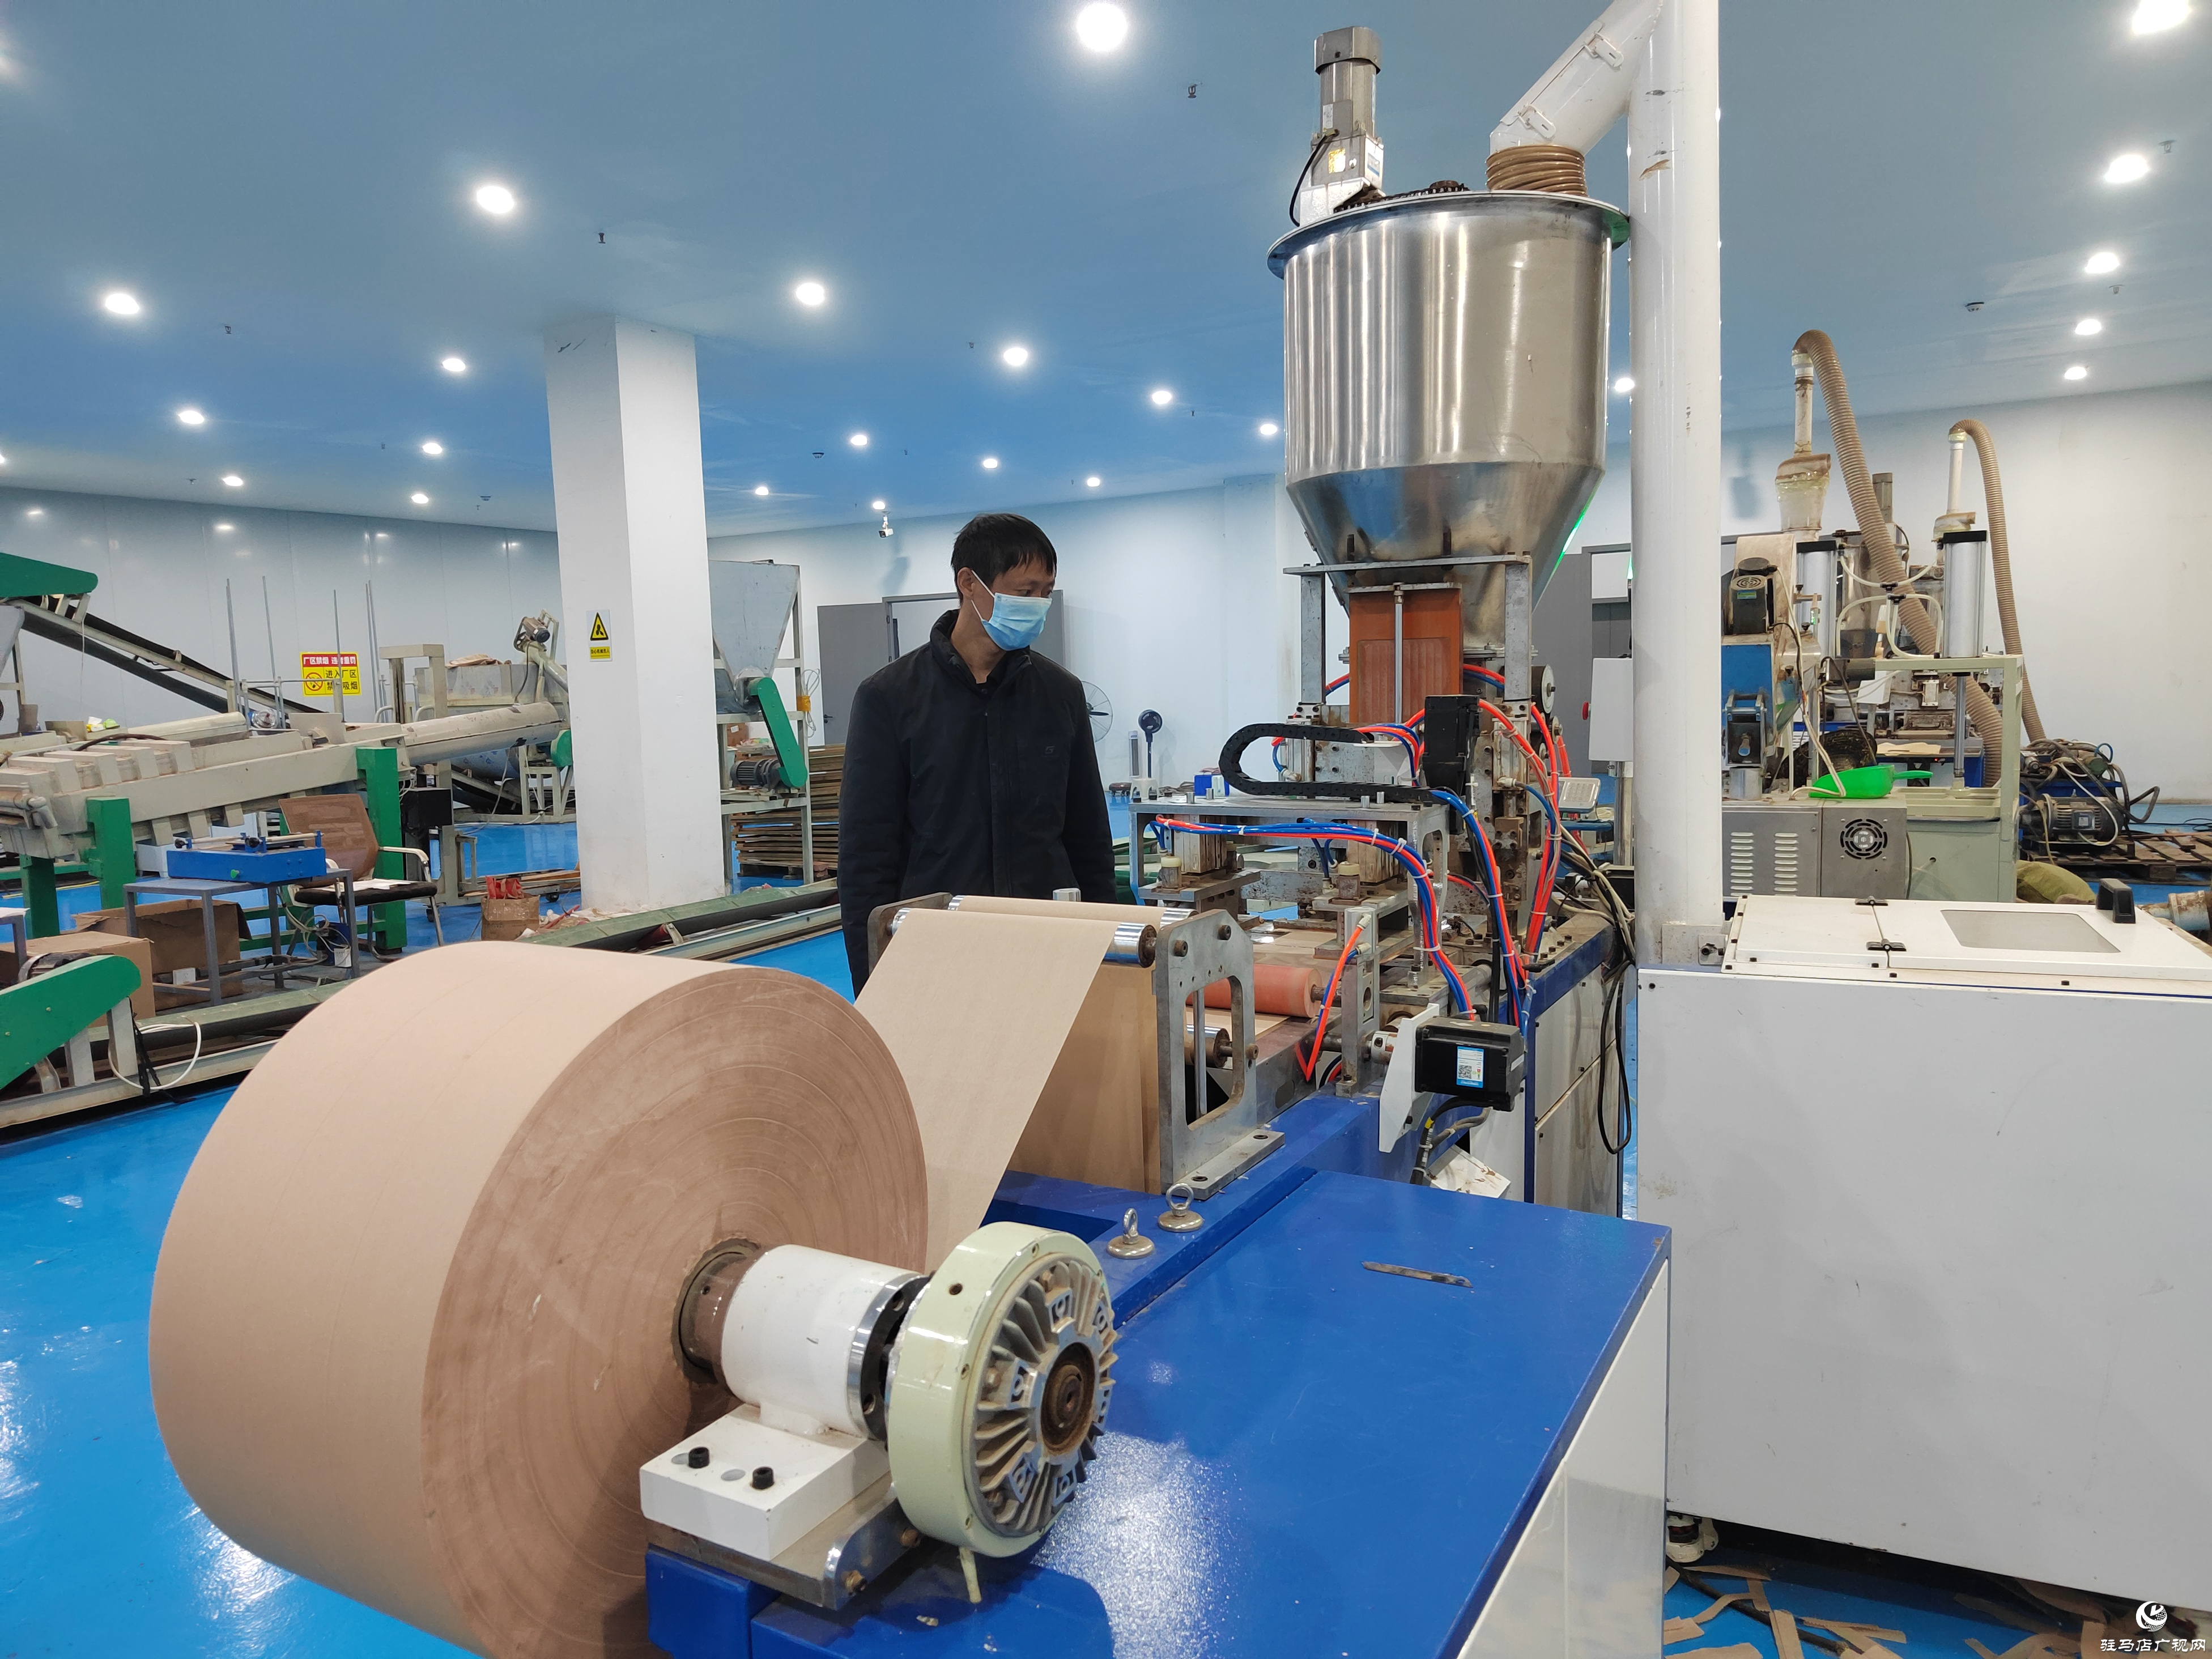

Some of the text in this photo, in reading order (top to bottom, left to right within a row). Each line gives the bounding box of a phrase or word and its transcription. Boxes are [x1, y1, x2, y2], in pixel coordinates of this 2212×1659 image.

[326, 670, 357, 678] 进入厂区
[327, 682, 358, 691] 禁吸烟
